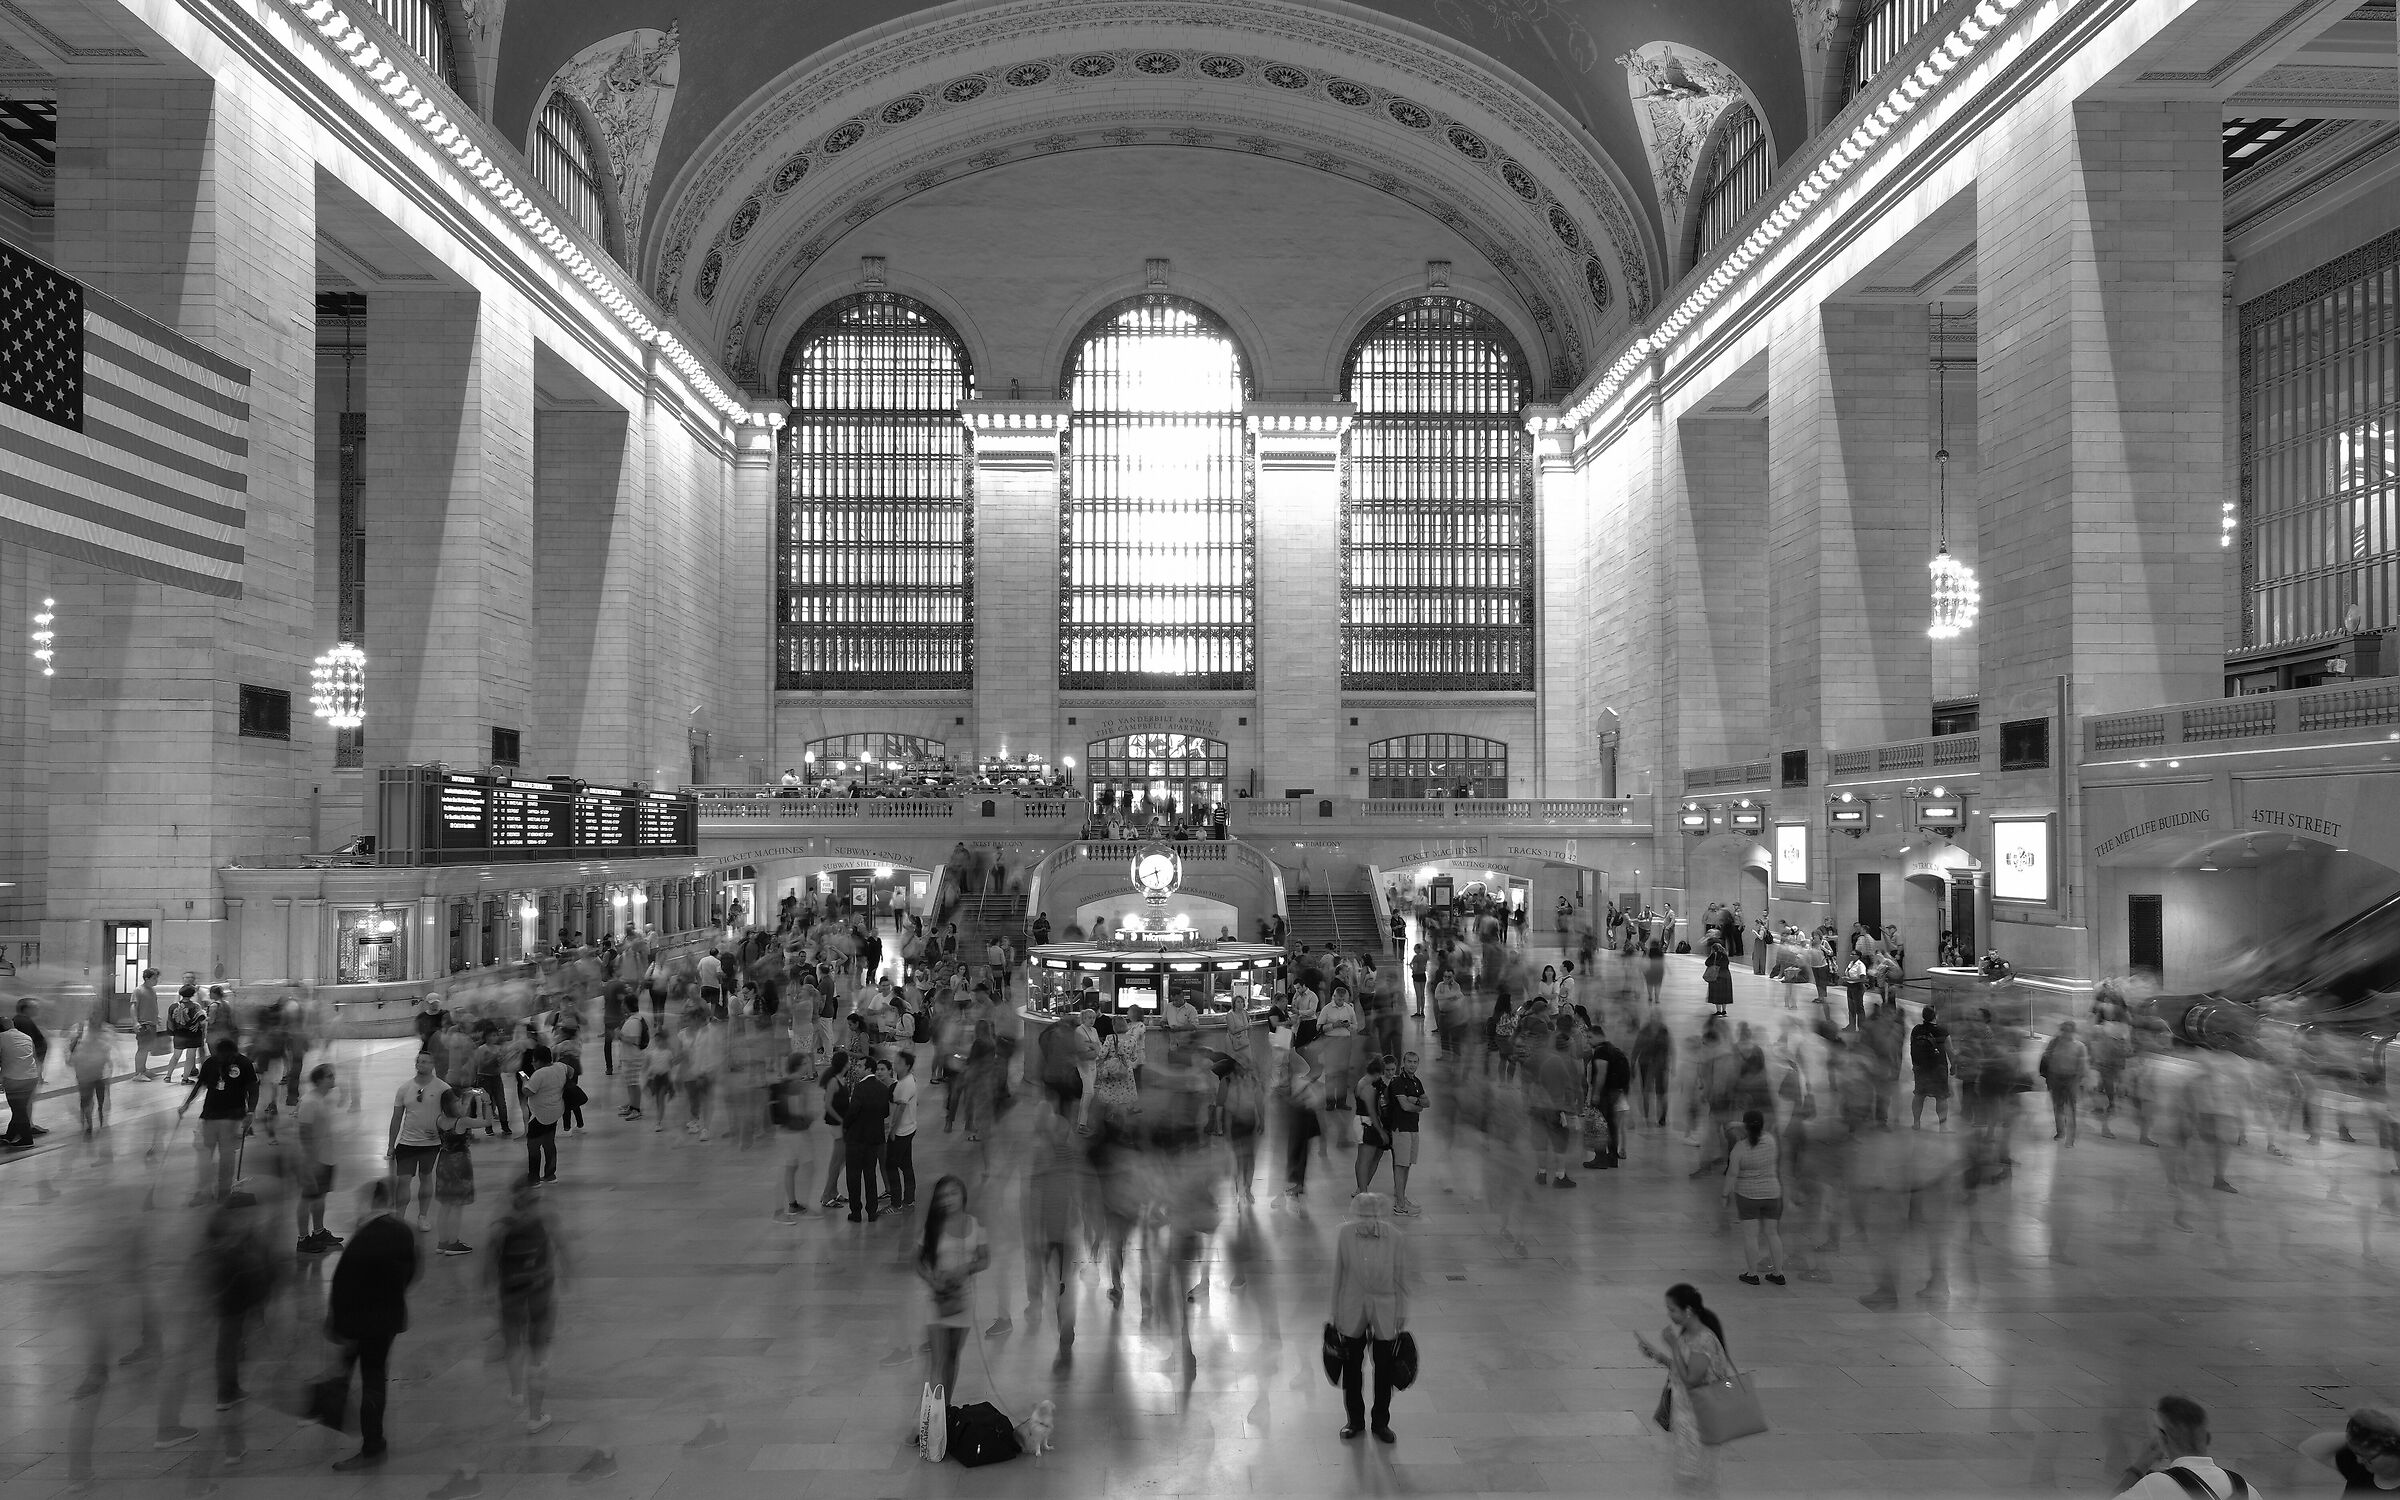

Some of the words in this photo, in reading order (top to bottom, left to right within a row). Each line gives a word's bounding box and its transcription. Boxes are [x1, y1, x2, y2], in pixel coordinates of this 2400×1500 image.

[1102, 720, 1114, 728] TO
[1118, 715, 1173, 724] VANDERBILT
[1179, 717, 1215, 727] AVENUE
[1096, 727, 1114, 737] THE
[1118, 723, 1163, 732] CAMPBELL
[1168, 724, 1220, 737] APARTMENT
[2251, 809, 2285, 826] 45TH
[2287, 813, 2342, 838] STREET
[2094, 838, 2114, 858] THE
[2114, 820, 2157, 847] METLIFE
[2158, 808, 2211, 831] BUILDING
[719, 851, 752, 864] TICKET
[753, 846, 804, 858] MACHINES
[834, 846, 872, 856] SUBWAY
[879, 851, 902, 861] 42ND
[903, 855, 915, 864] ST
[1399, 851, 1429, 863] TICKET
[1507, 846, 1542, 856] TRACKS
[1554, 851, 1566, 859] TO
[822, 861, 854, 870] SUBWAY
[1451, 860, 1485, 869] WAITING
[1487, 863, 1511, 872] ROOM
[1080, 892, 1103, 903] DINING
